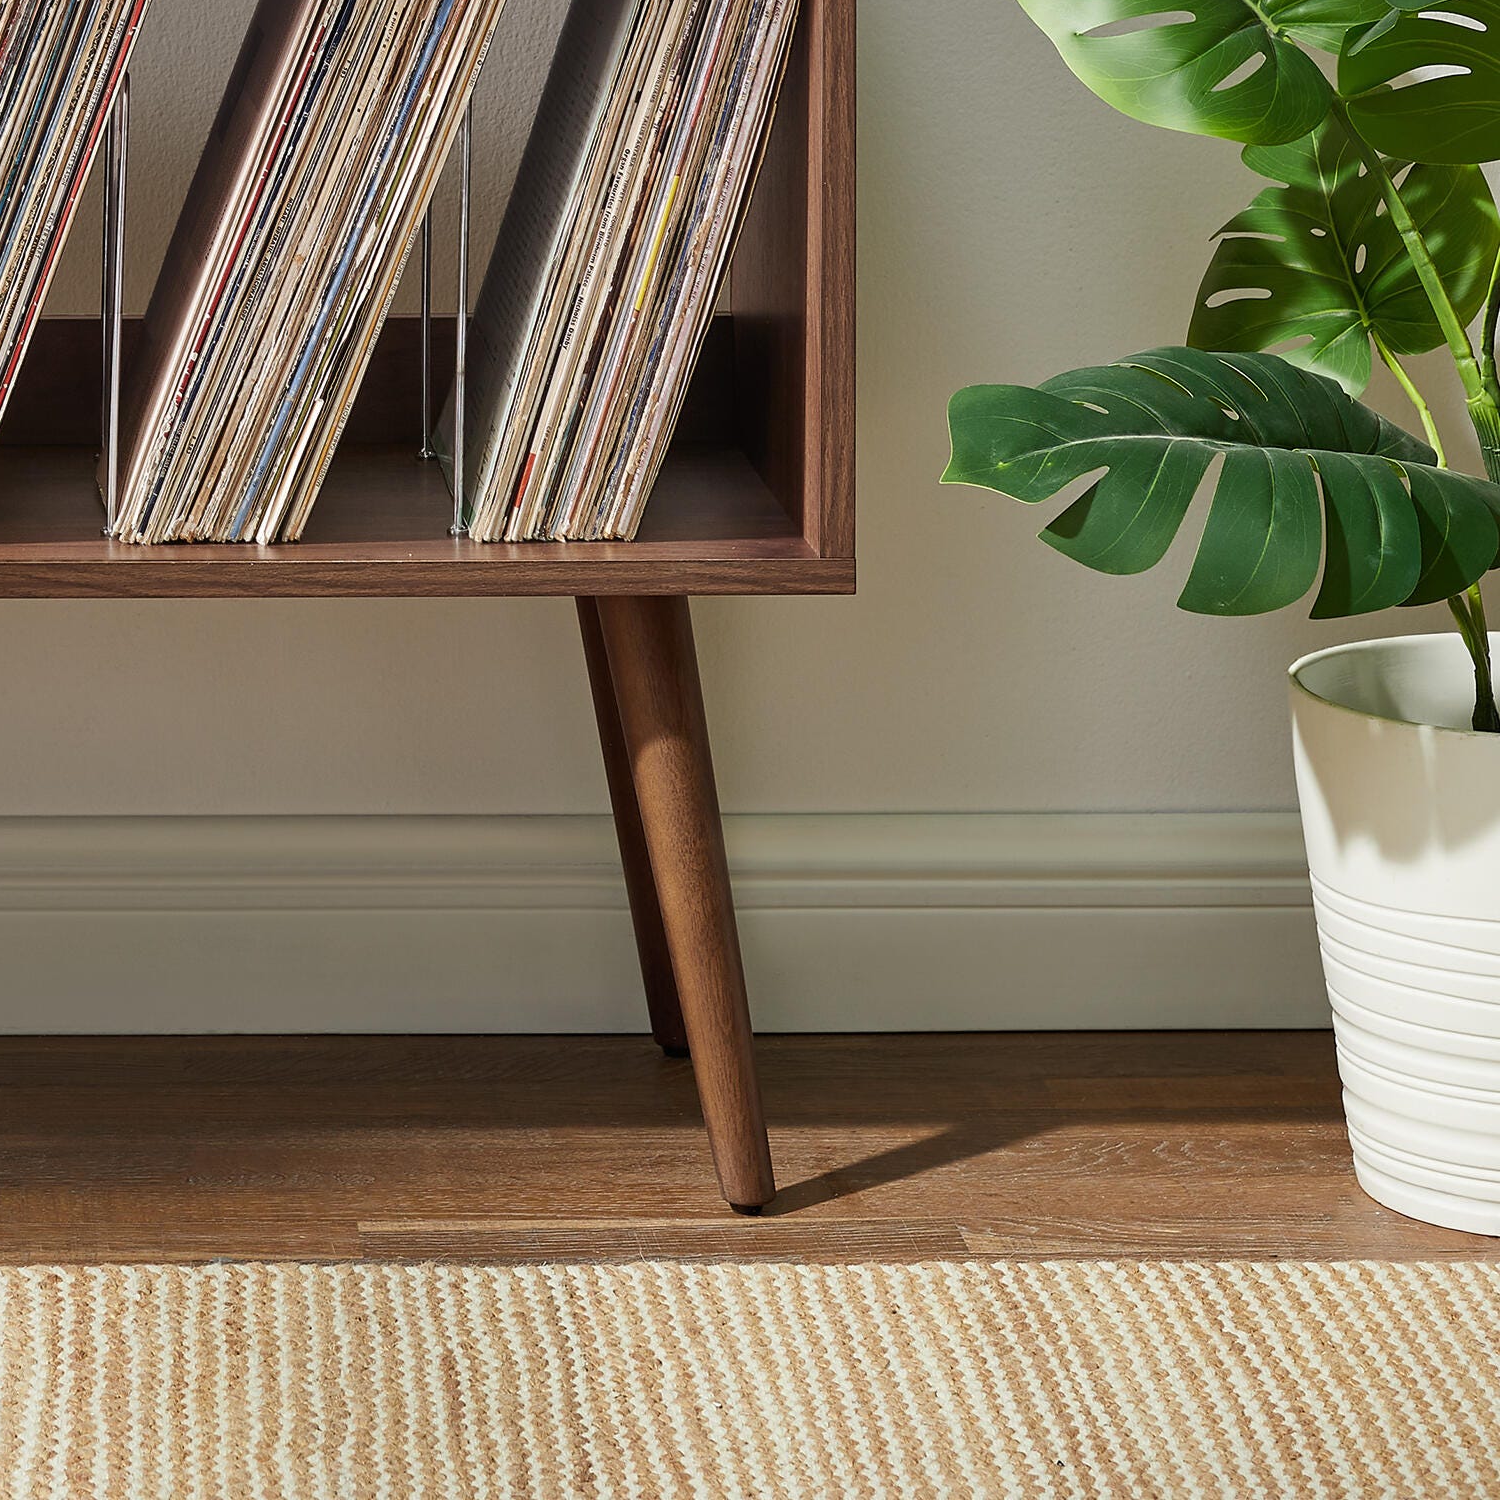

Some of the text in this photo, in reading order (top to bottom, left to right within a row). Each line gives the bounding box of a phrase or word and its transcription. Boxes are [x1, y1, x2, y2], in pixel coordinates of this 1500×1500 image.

[659, 42, 671, 73] VAUGHAN
[649, 74, 661, 103] WILLIAMS
[638, 114, 648, 136] TALLIS
[628, 136, 642, 168] FANTASIA
[617, 179, 628, 203] TIPPETT
[279, 196, 293, 222] MOZART
[267, 225, 282, 255] OPERATIC
[339, 399, 352, 423] RECITAL
[365, 324, 381, 355] ORQUESTA
[390, 282, 397, 291] DE
[468, 68, 478, 87] DECCA
[603, 214, 617, 248] CONCERTO
[34, 238, 45, 258] KRAFT
[560, 147, 630, 350] Organ Favourites from Blenheim Palace Nicholas Danby
